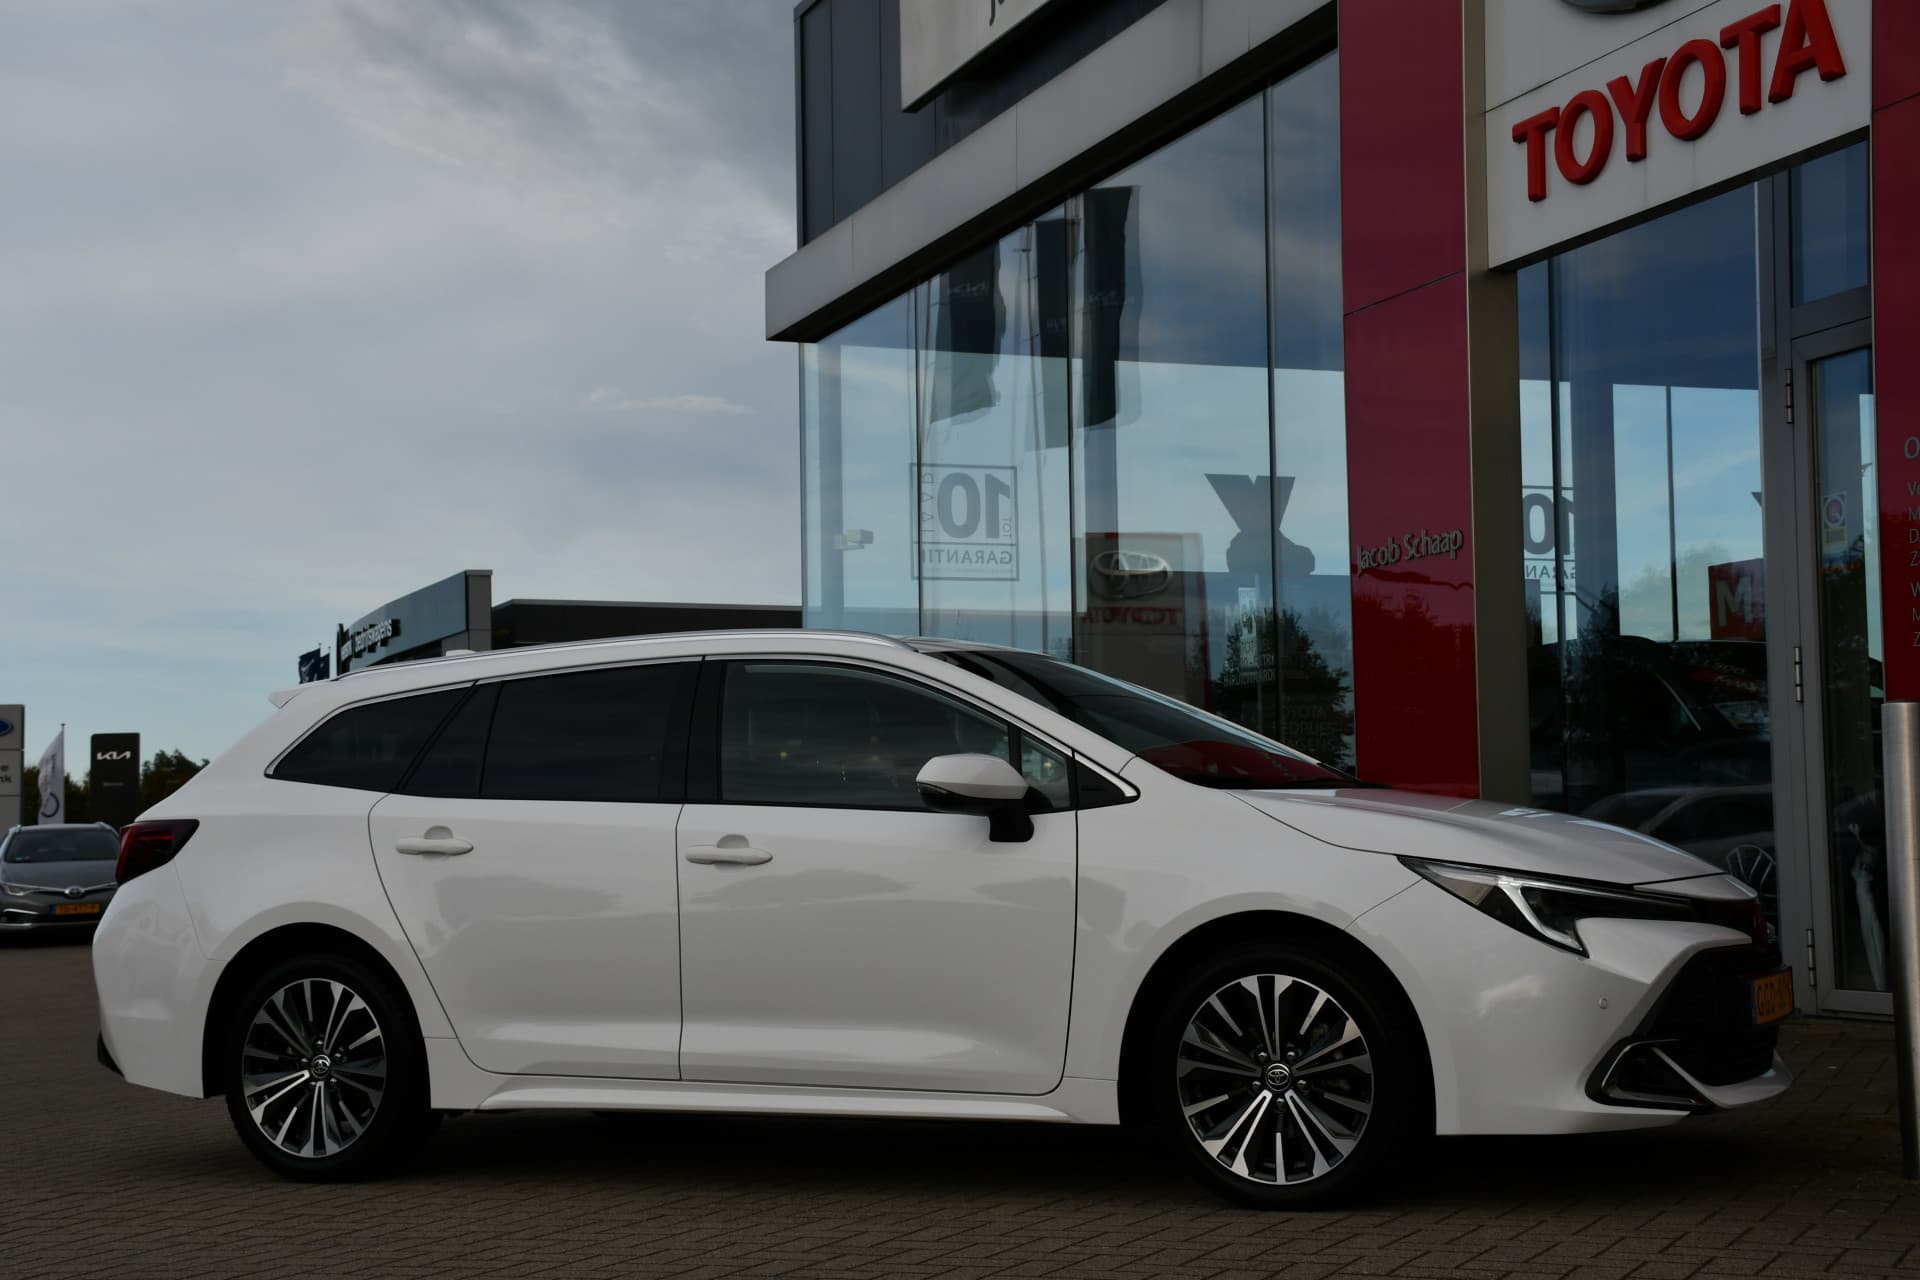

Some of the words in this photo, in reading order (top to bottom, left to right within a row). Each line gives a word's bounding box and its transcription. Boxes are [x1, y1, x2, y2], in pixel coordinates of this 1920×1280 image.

[1512, 0, 1847, 203] TOYOTA
[1903, 435, 1920, 459] O
[1356, 535, 1401, 576] Jacob
[1403, 528, 1463, 560] Schaap
[96, 750, 132, 760] KIA
